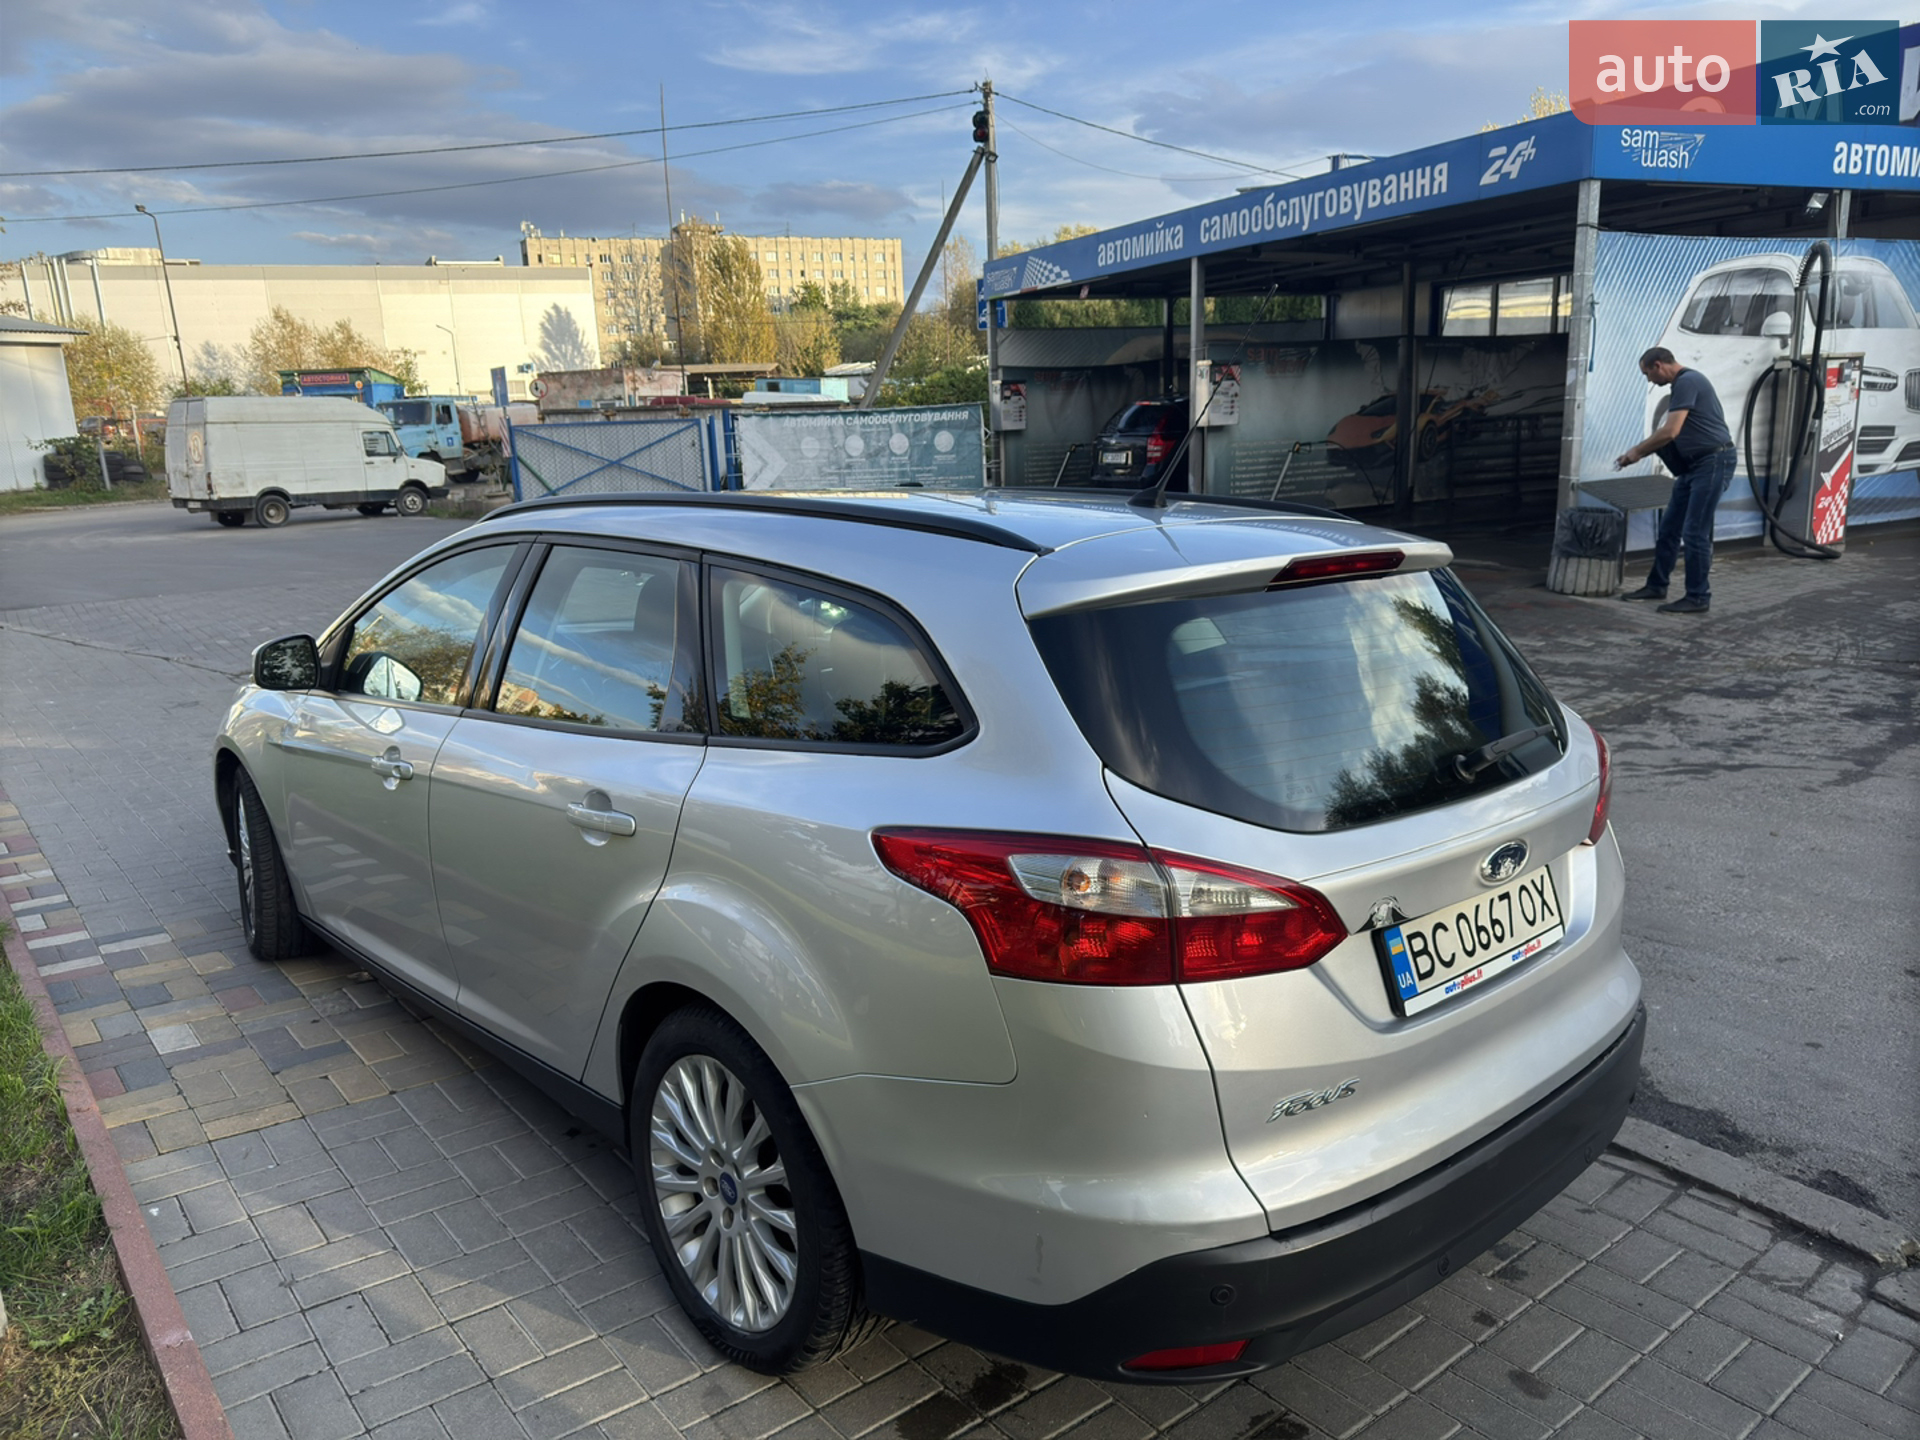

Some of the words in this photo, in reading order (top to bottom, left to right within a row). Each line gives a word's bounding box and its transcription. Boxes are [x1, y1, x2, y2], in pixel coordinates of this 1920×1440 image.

[1621, 128, 1659, 149] sam
[1641, 144, 1689, 169] wash
[1097, 221, 1184, 267] автомийка
[1200, 161, 1448, 244] самообслуговування
[782, 415, 844, 428] АВТОМИЙКА
[845, 410, 969, 426] САМООБСЛУГОВУВАННЯ
[1406, 921, 1456, 982] BC
[1456, 891, 1515, 958] 0667
[1397, 971, 1413, 989] UA
